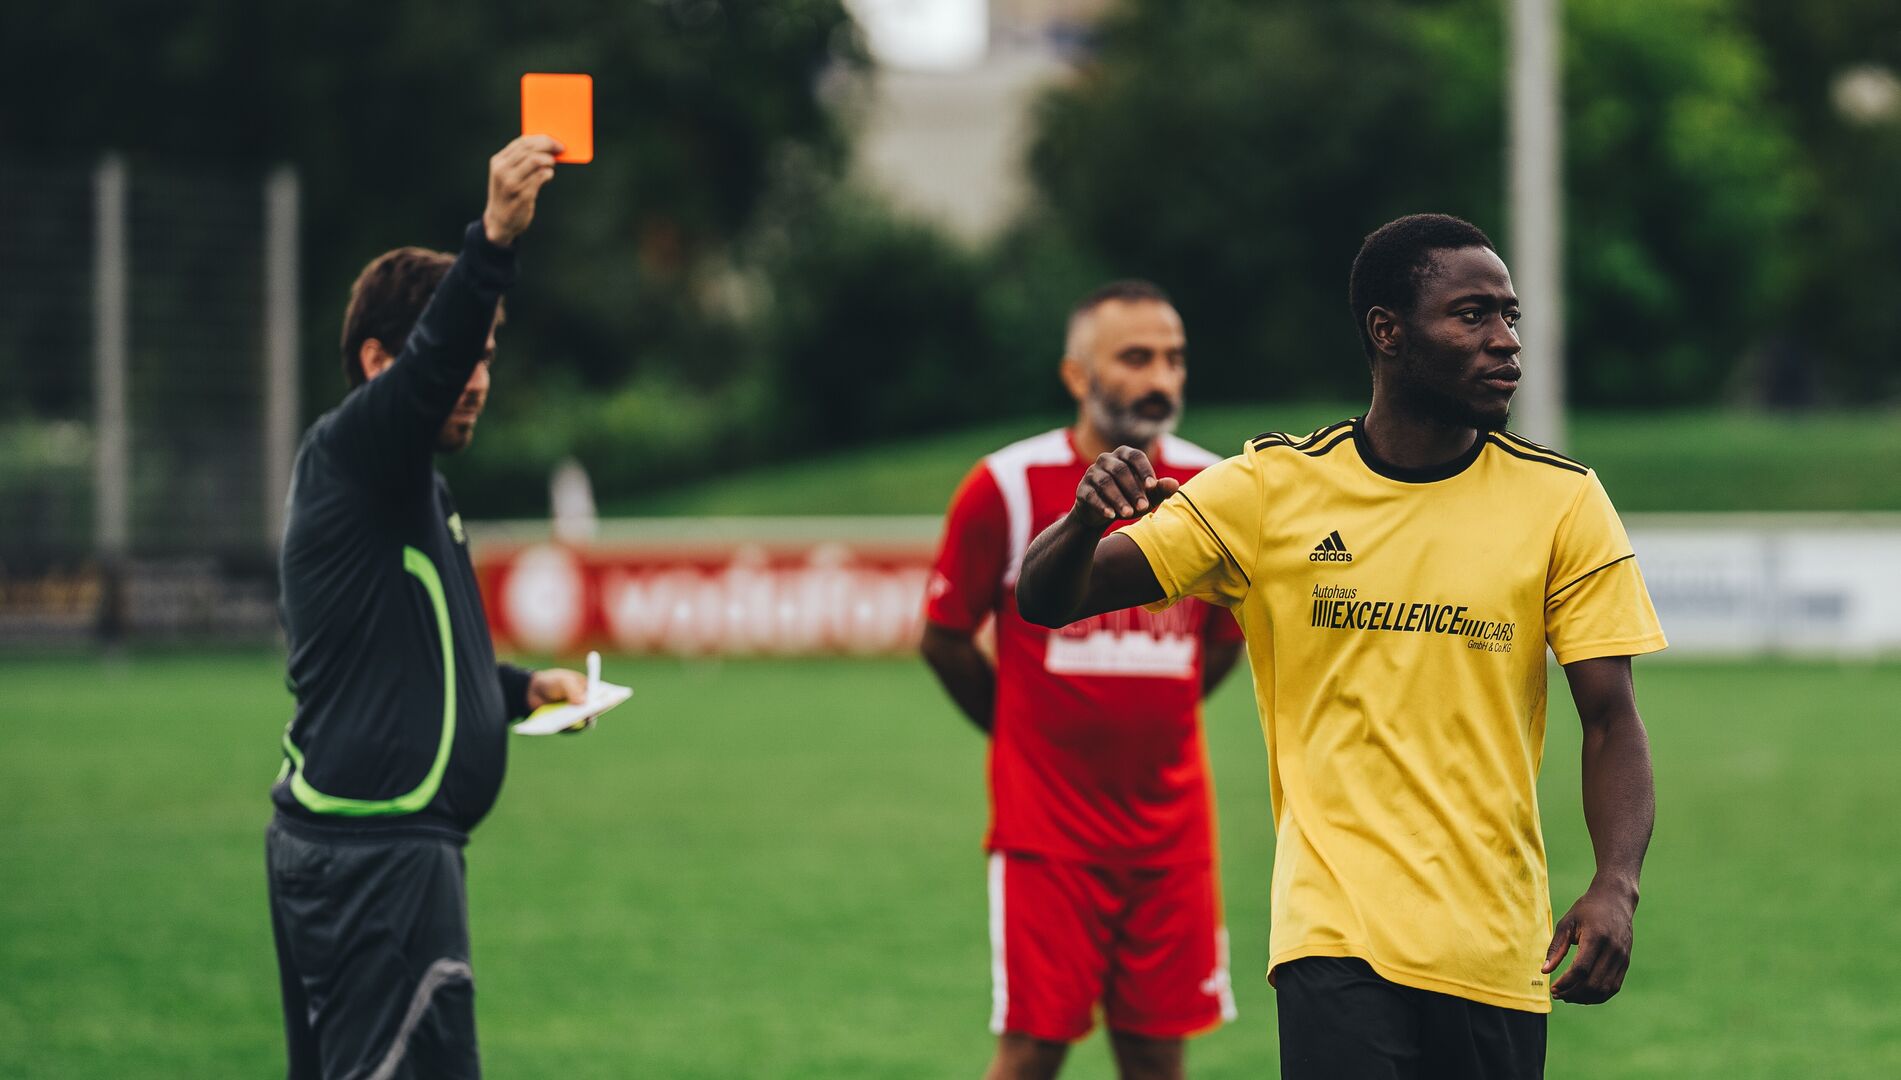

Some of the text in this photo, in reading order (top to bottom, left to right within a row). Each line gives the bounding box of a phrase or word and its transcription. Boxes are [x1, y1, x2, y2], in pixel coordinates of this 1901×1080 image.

[1309, 550, 1353, 562] adidas
[1312, 583, 1357, 599] Autohaus
[1330, 601, 1516, 642] EXCELLENCE CARS
[1467, 639, 1488, 651] GmbH
[1488, 642, 1494, 652] &
